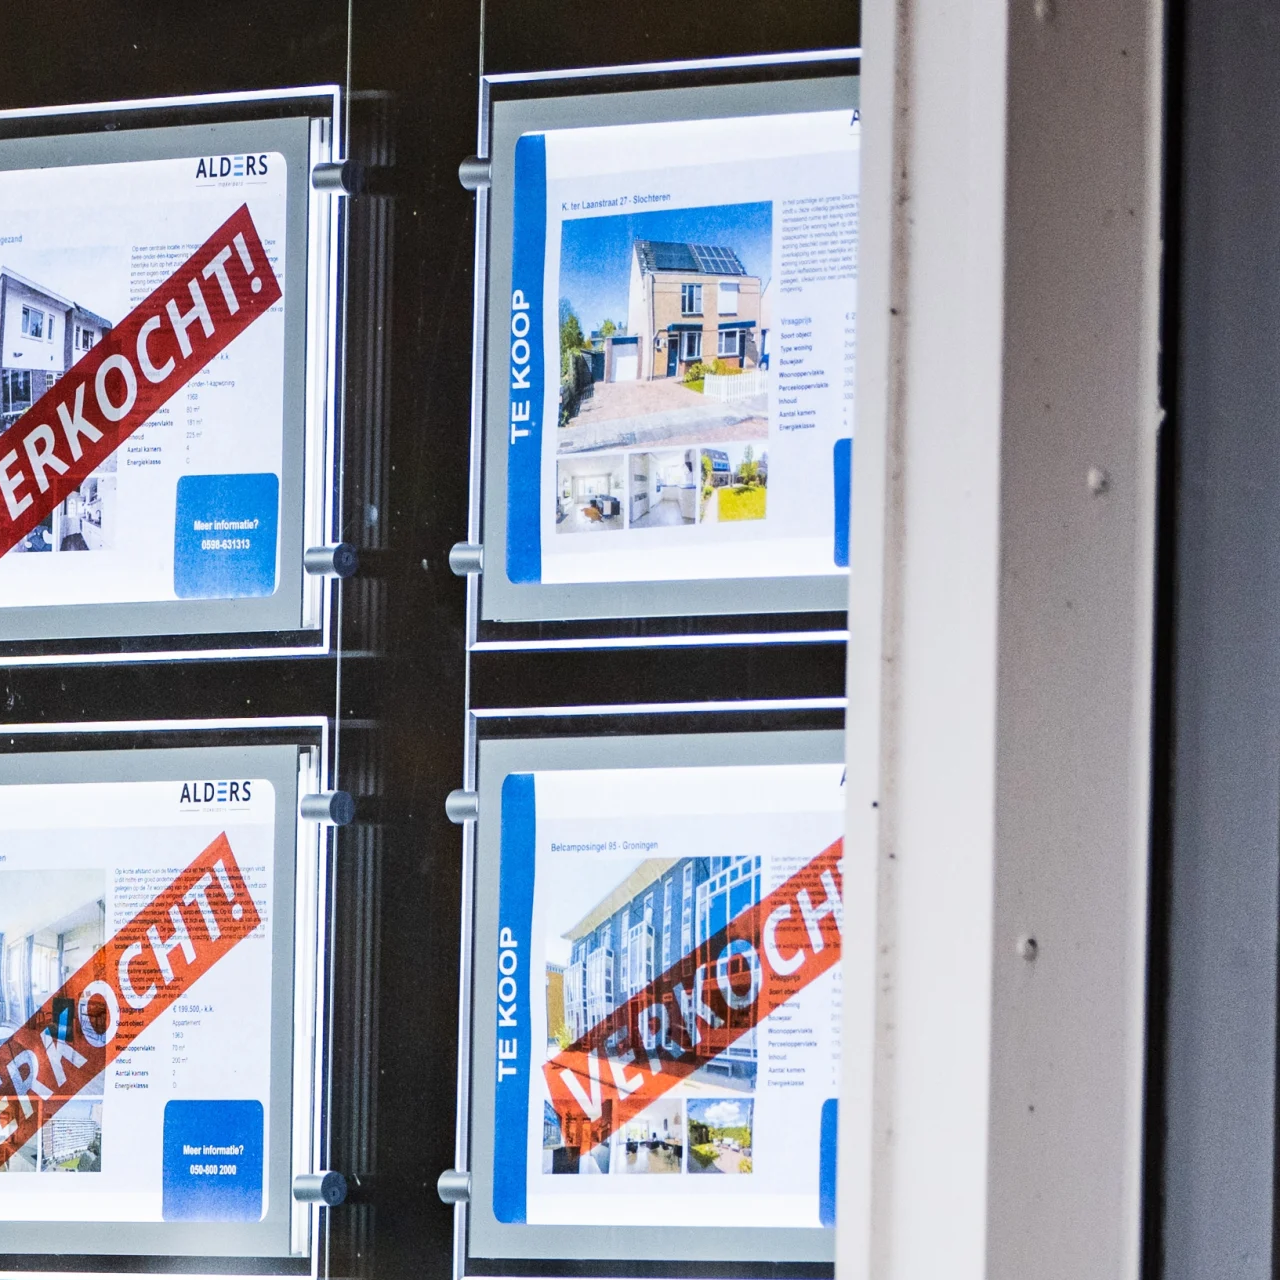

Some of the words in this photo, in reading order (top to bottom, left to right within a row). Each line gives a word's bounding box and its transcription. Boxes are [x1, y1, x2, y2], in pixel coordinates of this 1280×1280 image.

[196, 155, 268, 178] ALDERS
[582, 199, 618, 209] Laanstraat
[620, 197, 627, 205] 27
[633, 194, 671, 204] Slochteren
[511, 288, 531, 390] KOOP
[510, 400, 530, 445] TE
[194, 520, 212, 530] Meer
[214, 519, 258, 530] informatie?
[180, 781, 251, 803] ALDERS
[551, 842, 607, 853] Belcamposingel
[609, 842, 616, 850] 95
[623, 841, 658, 851] Groningen
[498, 927, 518, 1026] KOOP
[560, 857, 843, 1121] VERKOCH
[498, 1039, 517, 1082] TE
[183, 1145, 201, 1155] Meer
[203, 1145, 244, 1155] informatie?
[219, 1165, 236, 1175] 2000
